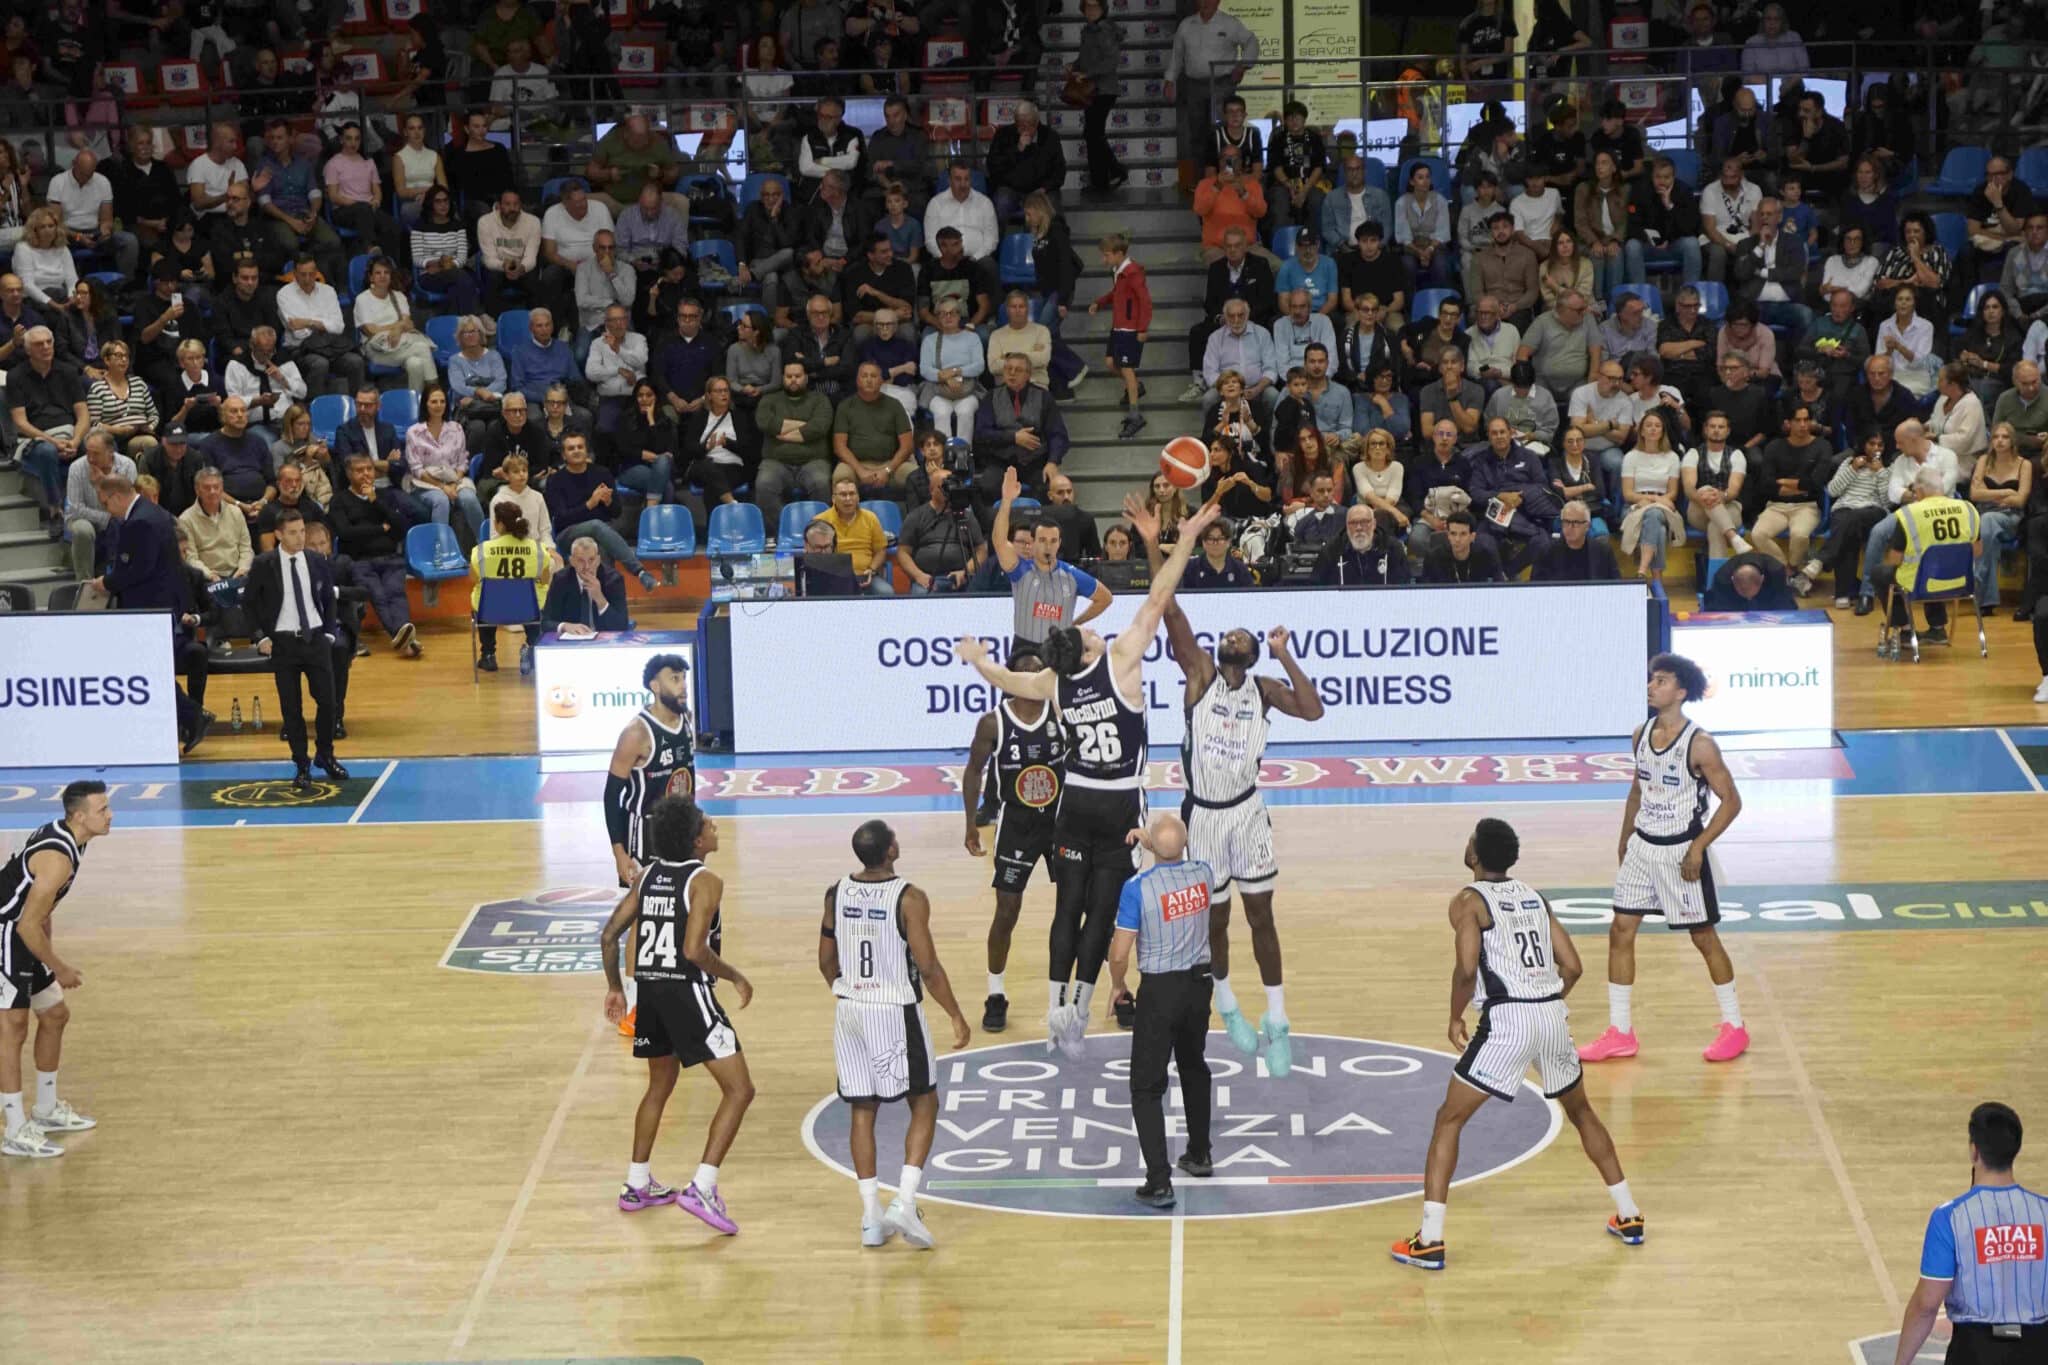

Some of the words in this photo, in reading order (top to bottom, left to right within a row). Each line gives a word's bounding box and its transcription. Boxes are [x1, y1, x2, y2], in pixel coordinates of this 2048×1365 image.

[1326, 36, 1357, 45] CAR
[1299, 46, 1356, 57] SERVICE
[1923, 506, 1963, 518] STEWARD
[1932, 517, 1961, 541] 60
[490, 546, 532, 556] STEWARD
[496, 557, 526, 579] 48
[1729, 665, 1820, 689] mimo.it
[0, 675, 151, 708] USINESS
[1075, 720, 1123, 763] 26
[659, 748, 674, 767] 45
[1010, 744, 1021, 761] 3
[846, 886, 887, 899] CAVIT
[1168, 885, 1205, 907] ATTAL
[641, 895, 677, 917] BATTLE
[1168, 896, 1207, 917] GROUP
[490, 920, 603, 937] LB
[516, 936, 597, 944] SERIE
[637, 920, 677, 968] 24
[1514, 930, 1546, 968] 26
[509, 961, 600, 972] Club
[860, 939, 874, 979] 8
[949, 1060, 1060, 1084] IO
[1984, 1226, 2038, 1246] ATTAL
[1984, 1242, 2038, 1257] GROUP
